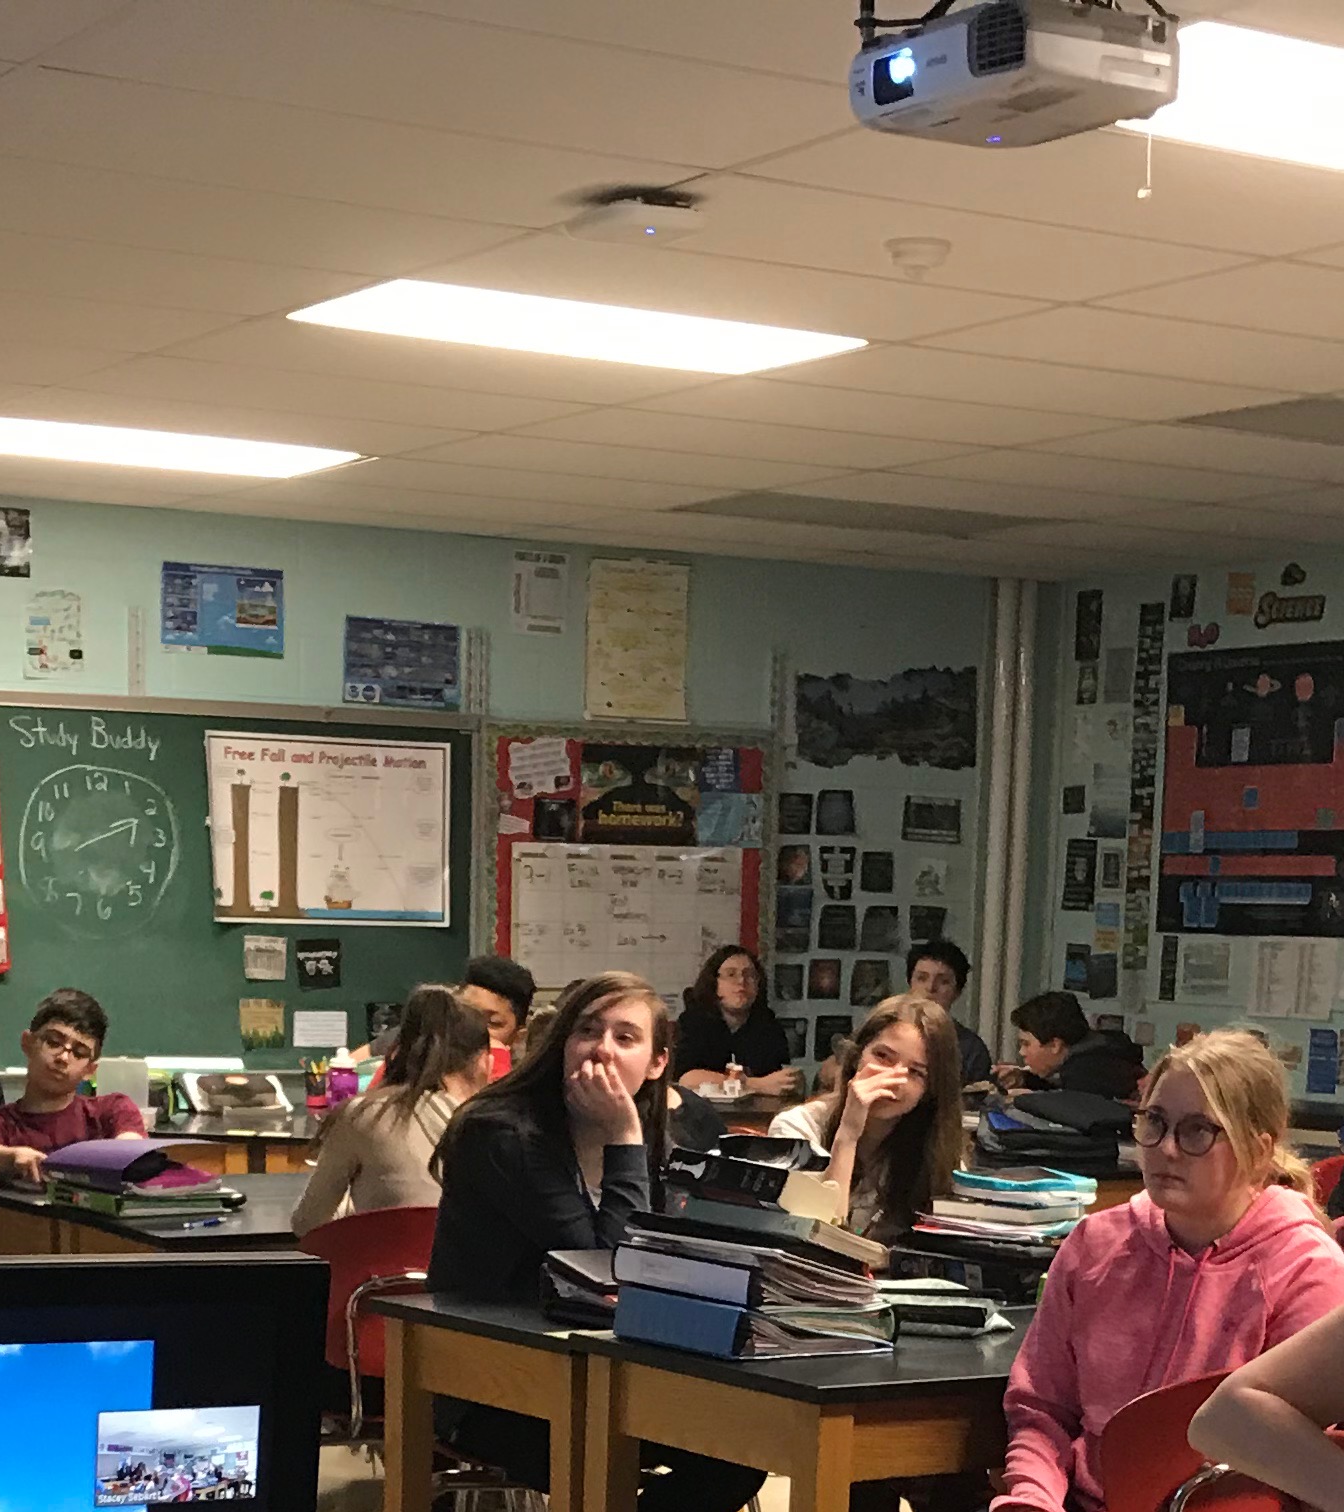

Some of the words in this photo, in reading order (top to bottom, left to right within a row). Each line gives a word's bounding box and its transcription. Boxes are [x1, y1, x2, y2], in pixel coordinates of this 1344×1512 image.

[9, 715, 79, 755] Study
[91, 716, 160, 761] Buddy
[223, 745, 256, 762] Free
[260, 747, 286, 763] Fall
[291, 751, 314, 764] and
[318, 750, 378, 769] Projectile
[85, 772, 109, 791] 12
[38, 800, 55, 822] 10
[145, 798, 157, 816] 2
[598, 810, 685, 828] homework?
[31, 831, 49, 863] 9
[153, 828, 167, 847] 3
[139, 860, 156, 884] 4
[66, 892, 83, 916] 7
[126, 880, 143, 906] 5
[96, 898, 112, 921] 6
